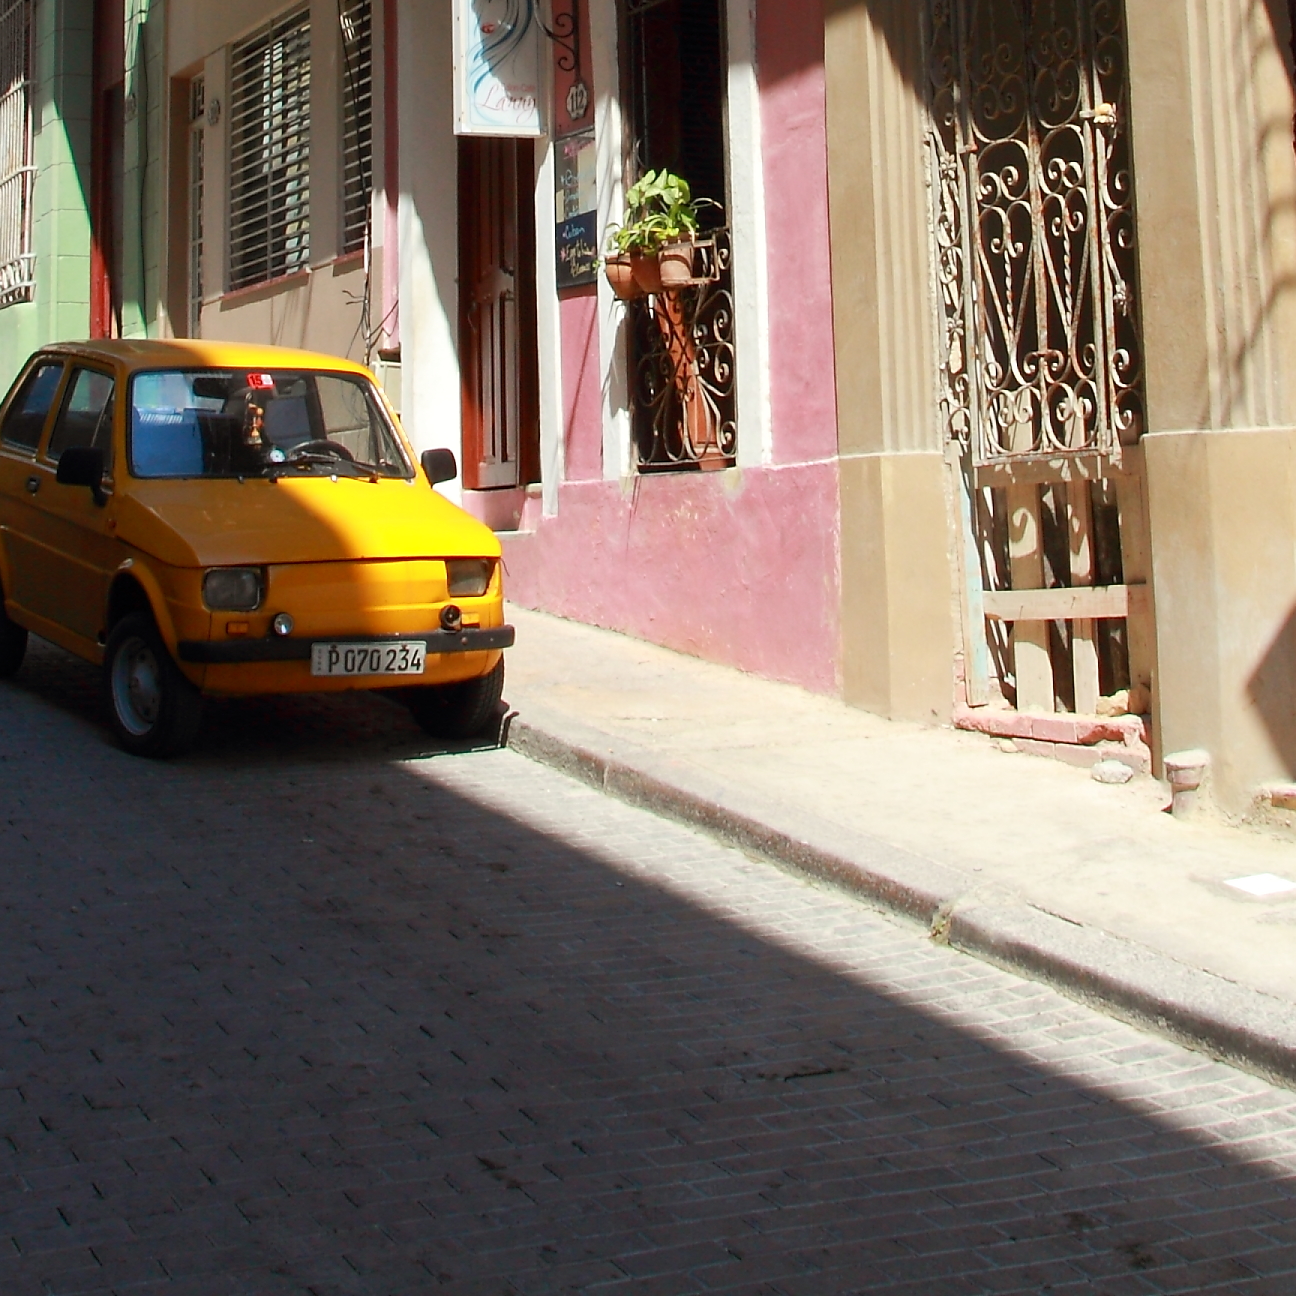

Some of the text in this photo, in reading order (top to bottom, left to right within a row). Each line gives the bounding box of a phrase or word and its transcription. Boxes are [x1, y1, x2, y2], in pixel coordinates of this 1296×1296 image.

[569, 89, 585, 113] 112
[249, 375, 263, 386] 15
[328, 649, 340, 673] P
[344, 649, 382, 673] 070
[385, 649, 422, 672] 234
